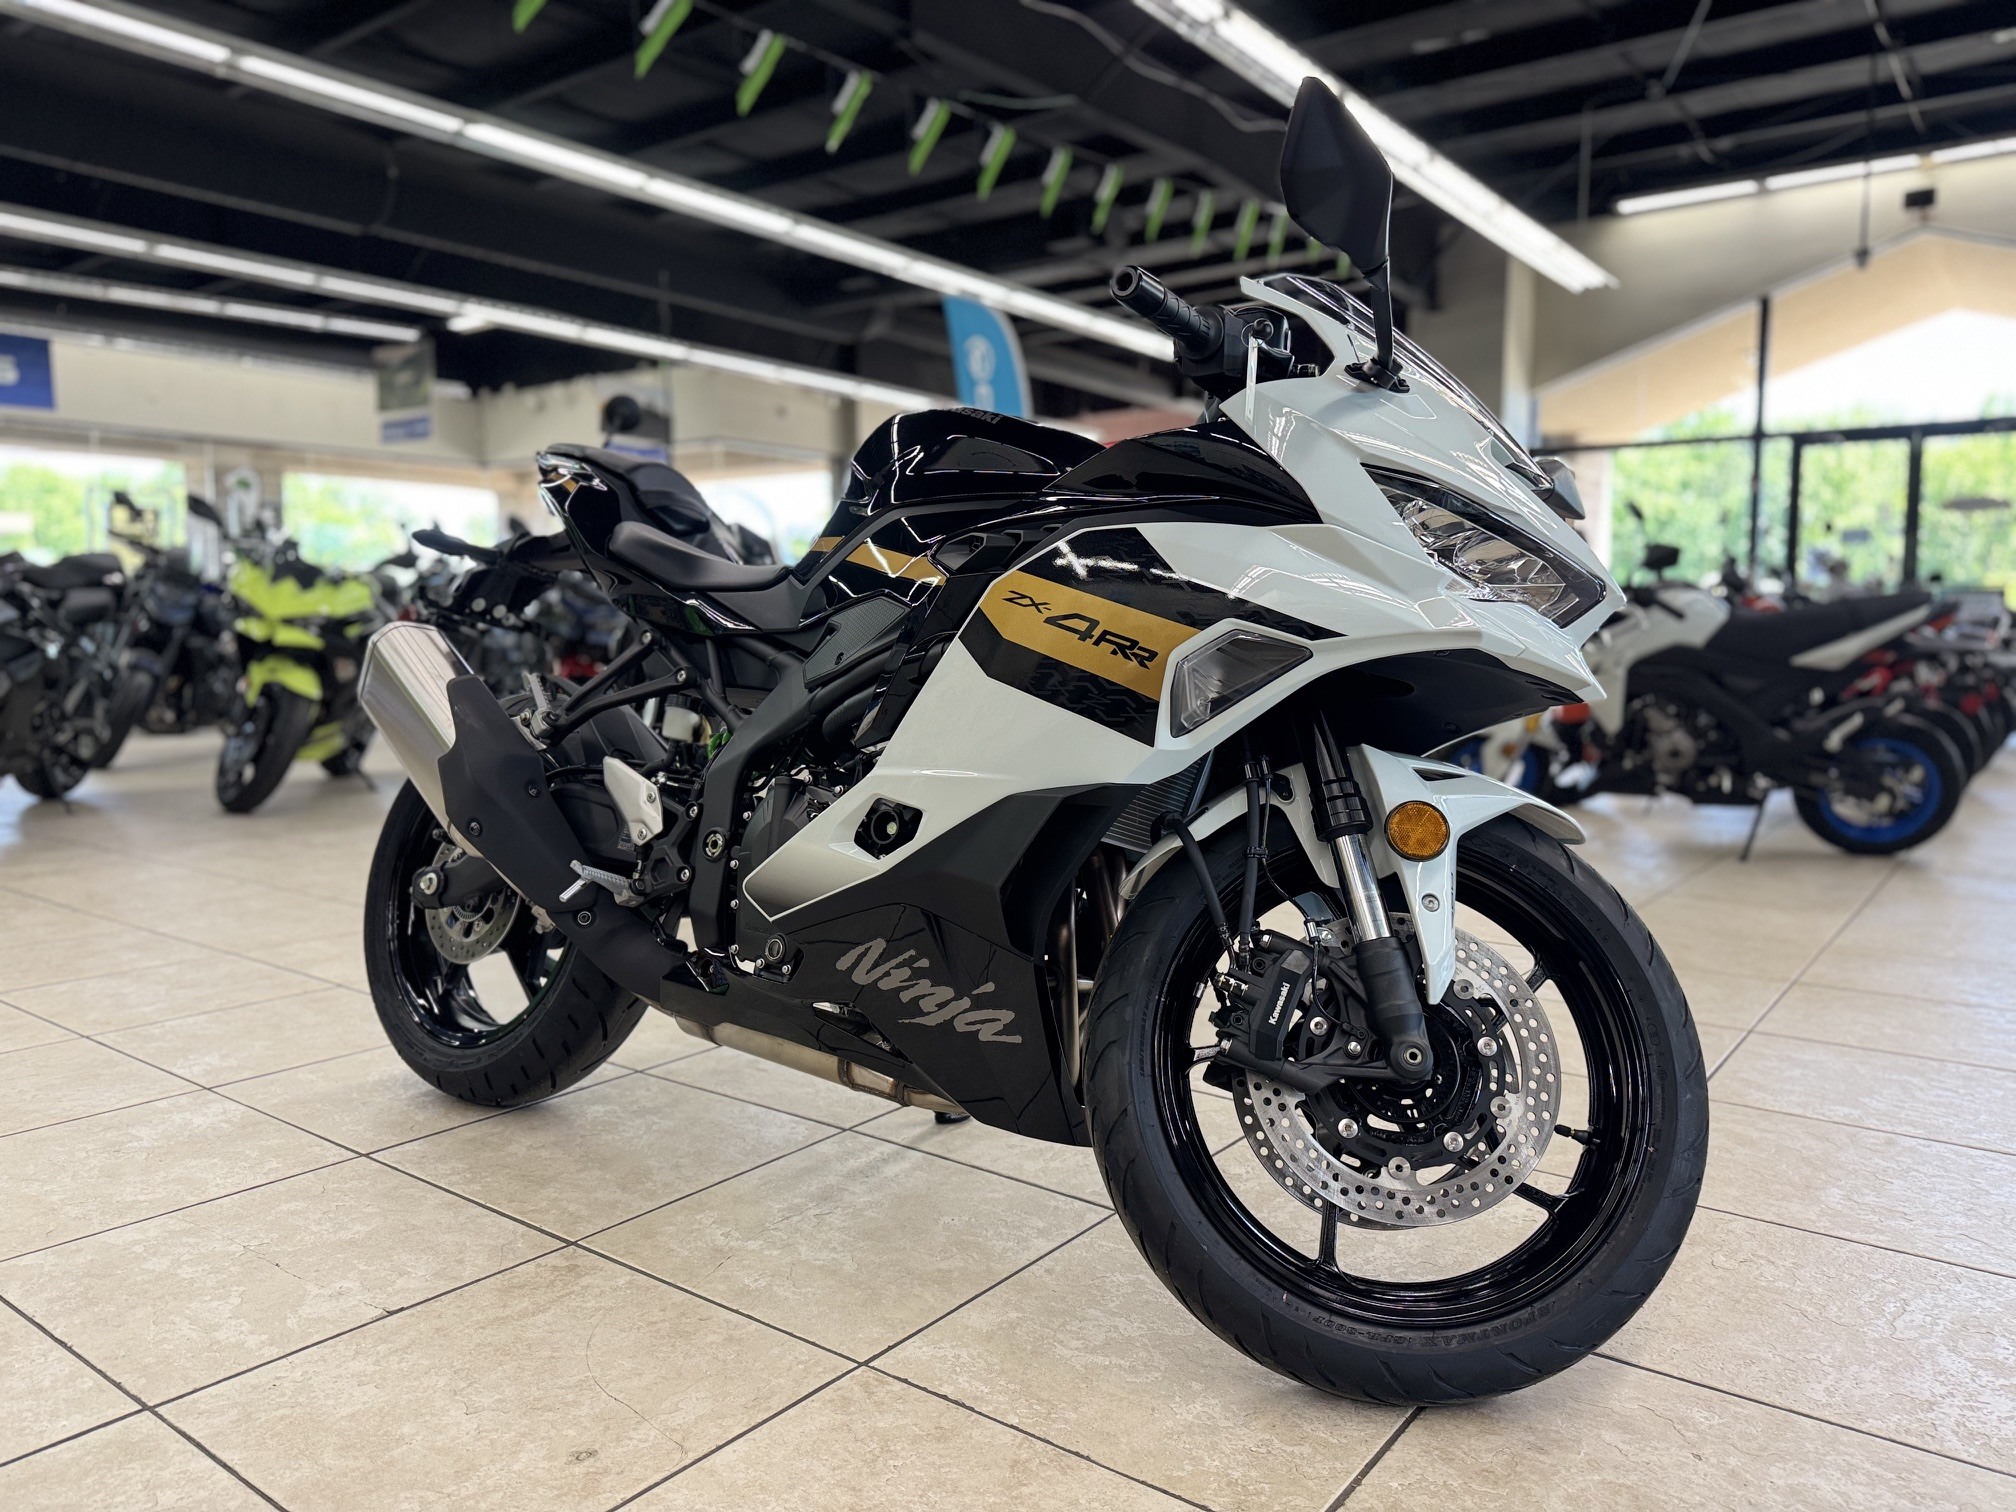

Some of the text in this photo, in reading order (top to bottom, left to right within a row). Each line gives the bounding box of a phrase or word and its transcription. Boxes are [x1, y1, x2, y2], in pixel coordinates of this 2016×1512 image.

[1002, 591, 1160, 669] ZX-4RR
[836, 938, 1022, 1043] Ninja
[1269, 982, 1291, 1025] Kawasaki
[1421, 1303, 1552, 1347] SPORTMAX
